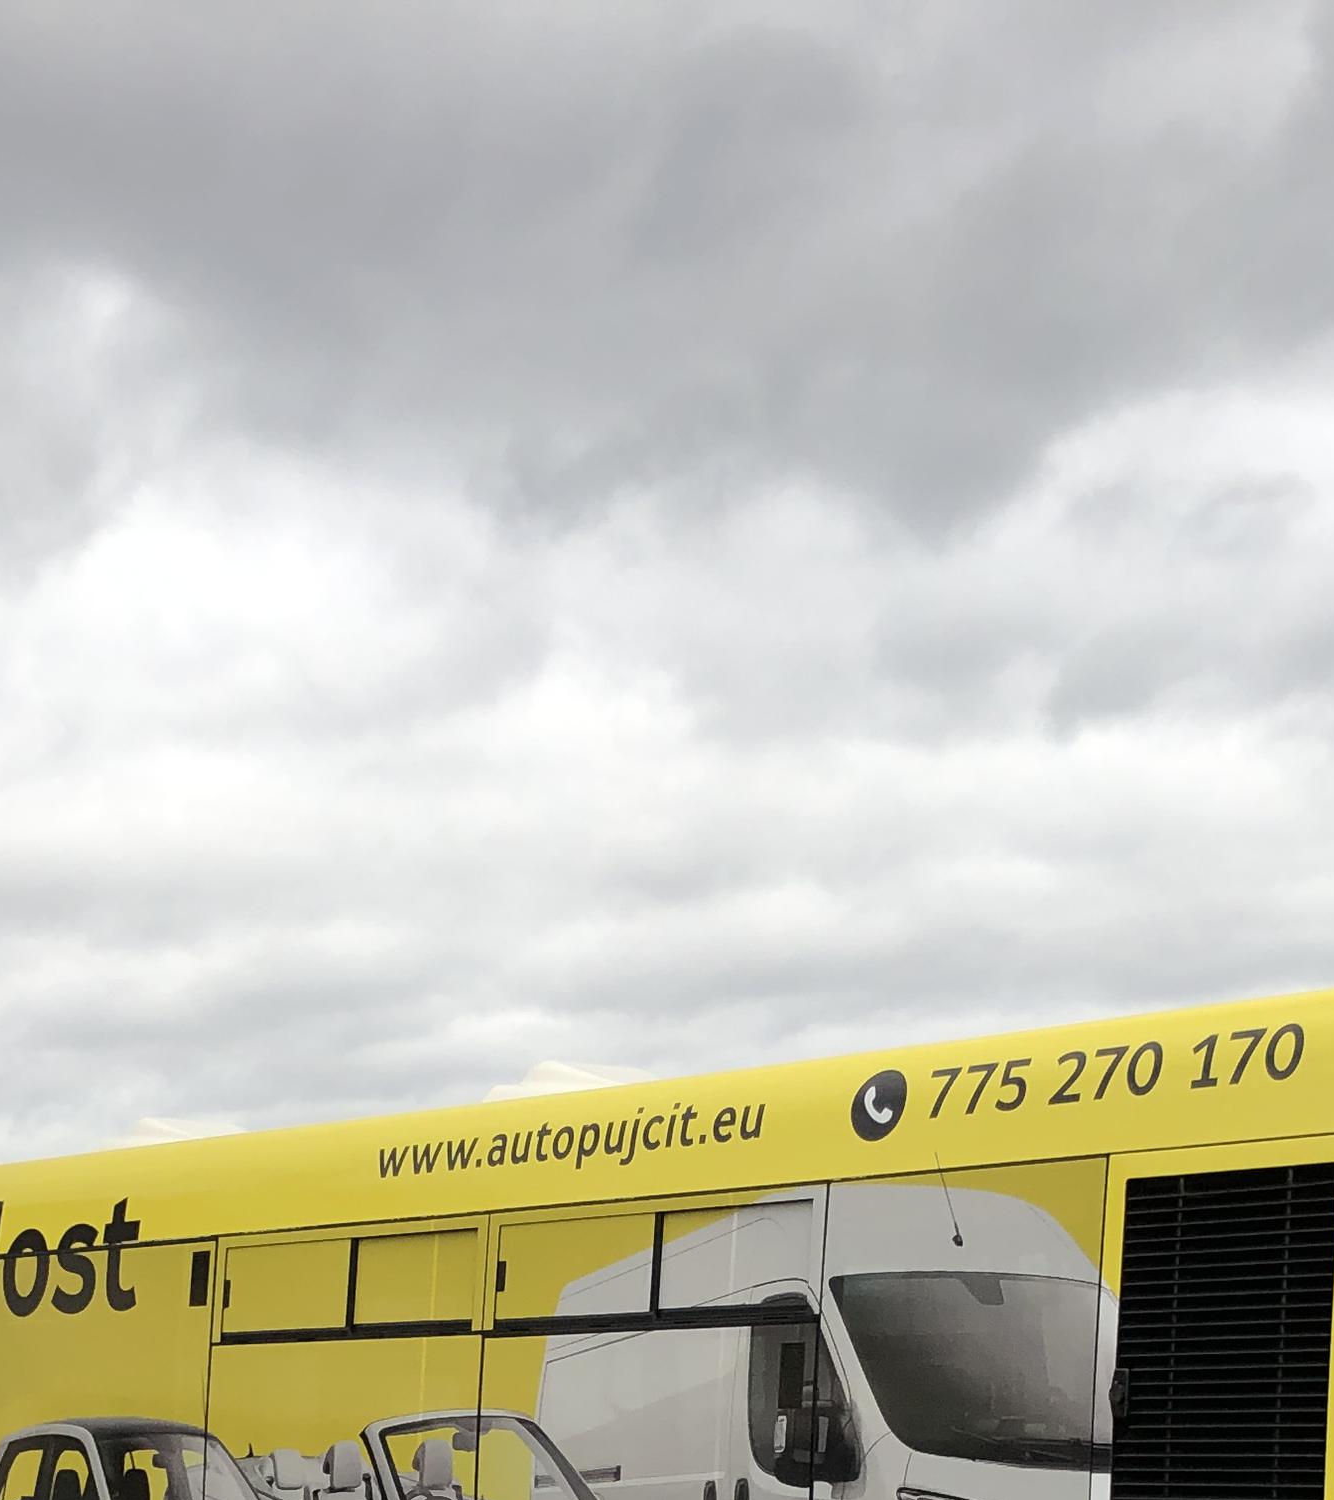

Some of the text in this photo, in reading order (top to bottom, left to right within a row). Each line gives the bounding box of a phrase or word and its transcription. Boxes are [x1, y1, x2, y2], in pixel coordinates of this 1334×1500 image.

[929, 1023, 1305, 1120] 775 270 170
[378, 1102, 766, 1179] www.autopujcit.eu
